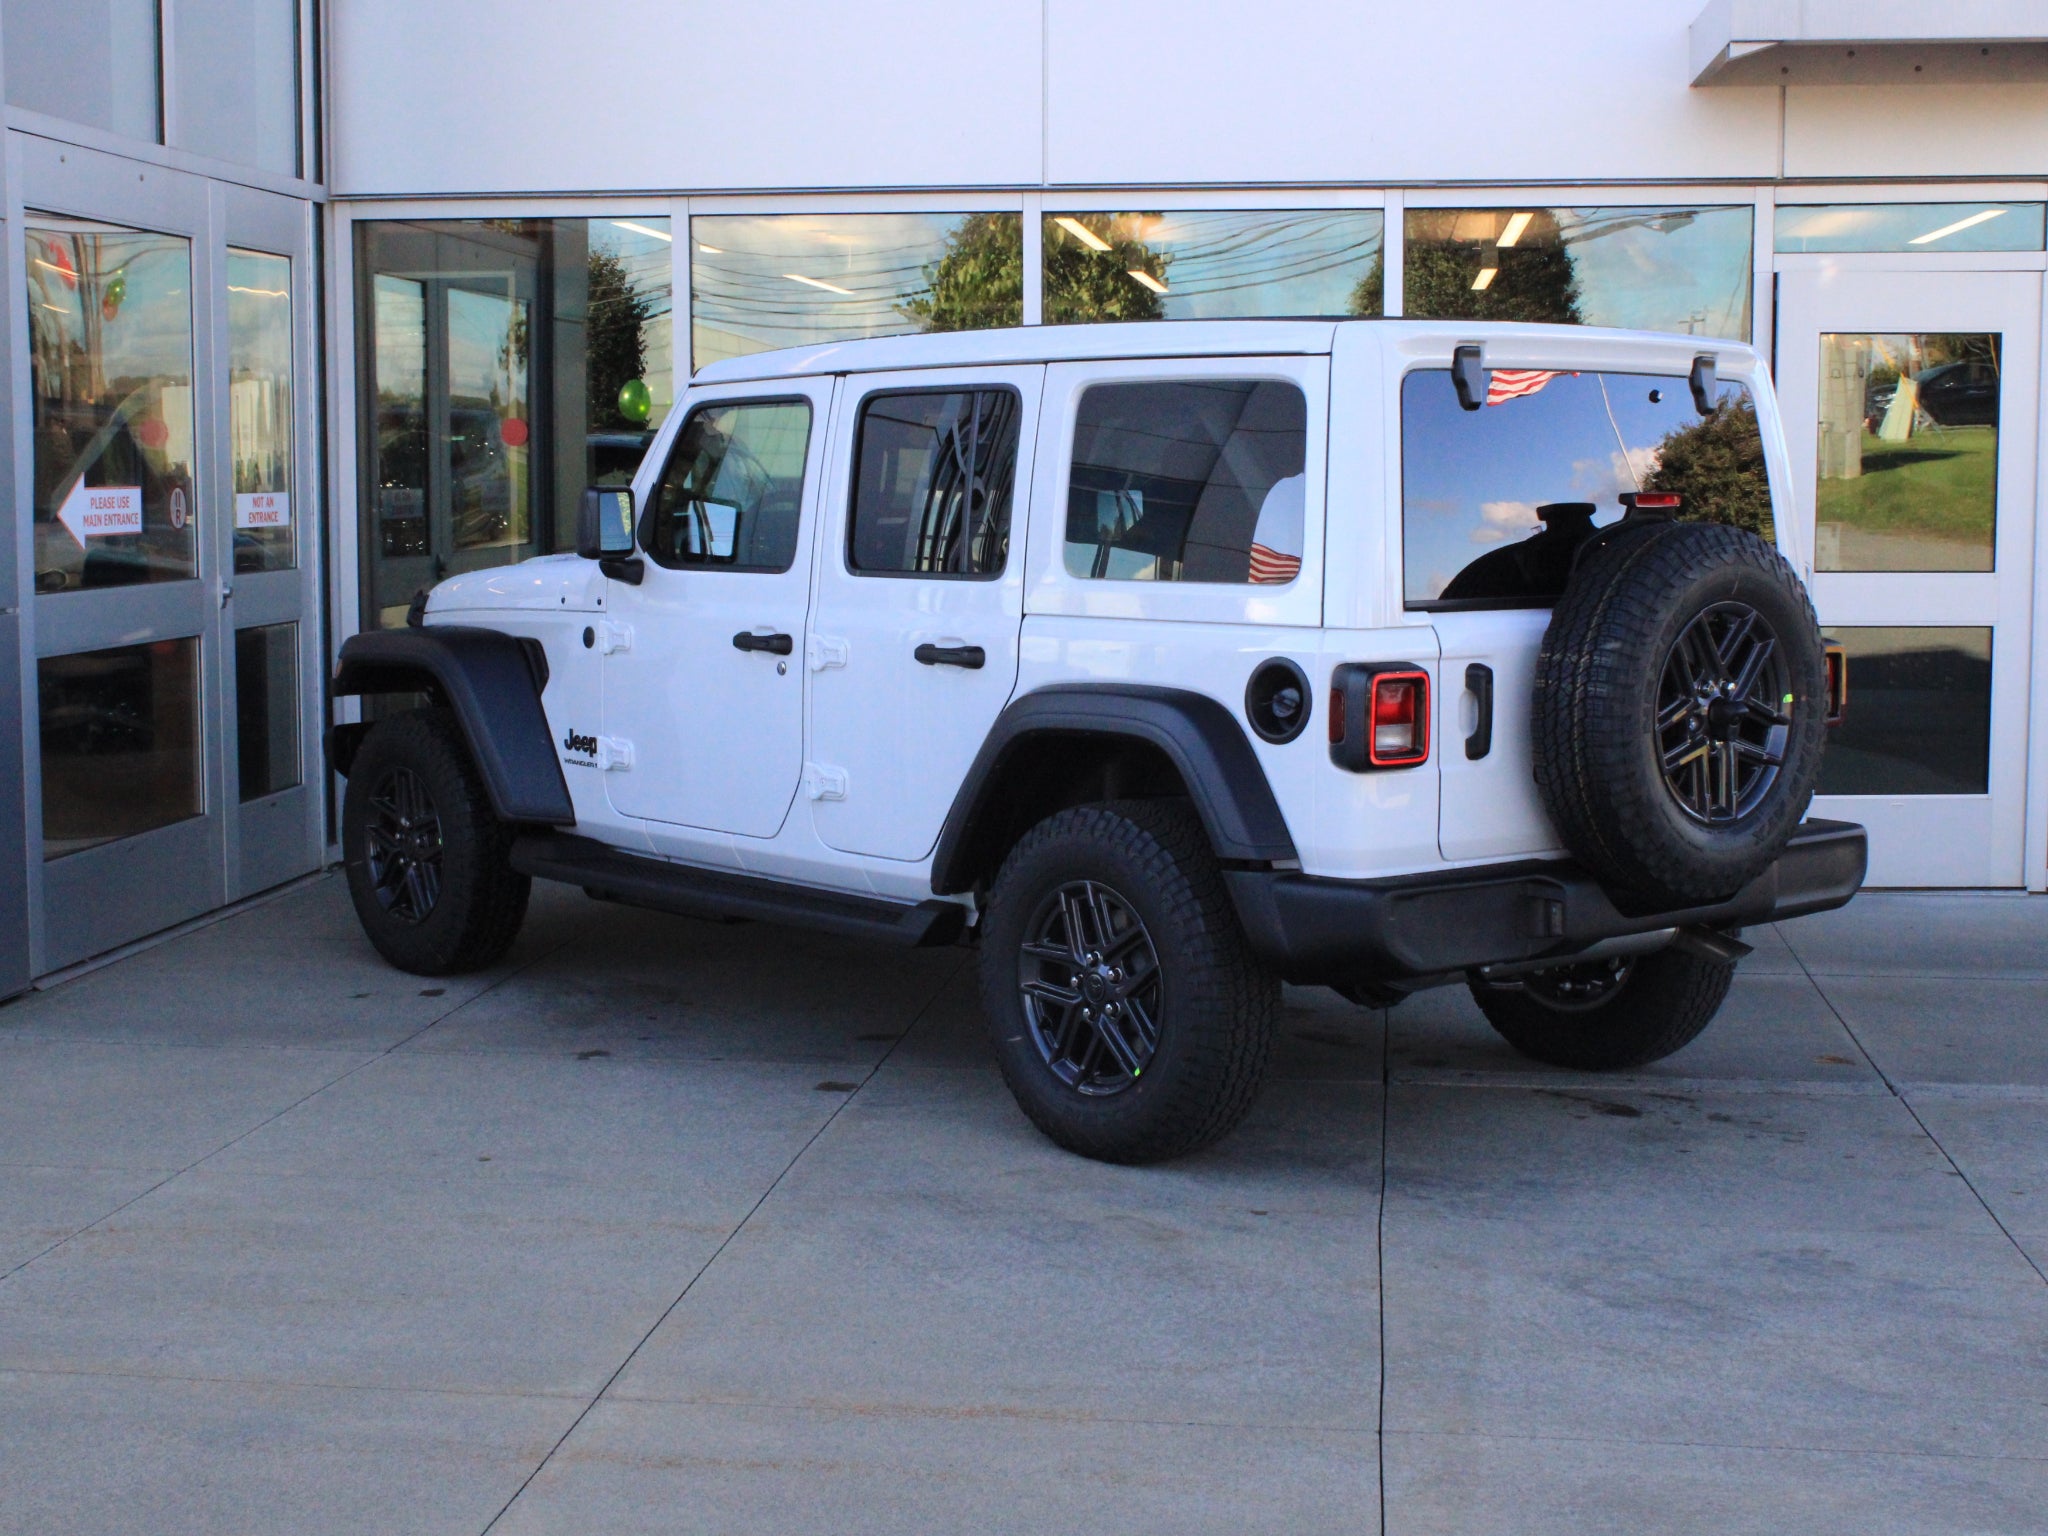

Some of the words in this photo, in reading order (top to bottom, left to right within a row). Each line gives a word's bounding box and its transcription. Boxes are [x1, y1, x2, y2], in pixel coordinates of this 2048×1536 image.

[90, 496, 115, 509] PLEASE
[117, 495, 130, 509] USE
[252, 496, 264, 508] NOT
[266, 495, 275, 508] AN
[83, 513, 102, 527] MAIN
[103, 512, 139, 526] ENTRANCE
[175, 509, 182, 525] R
[248, 511, 279, 524] ENTRANCE
[564, 728, 597, 758] Jeep
